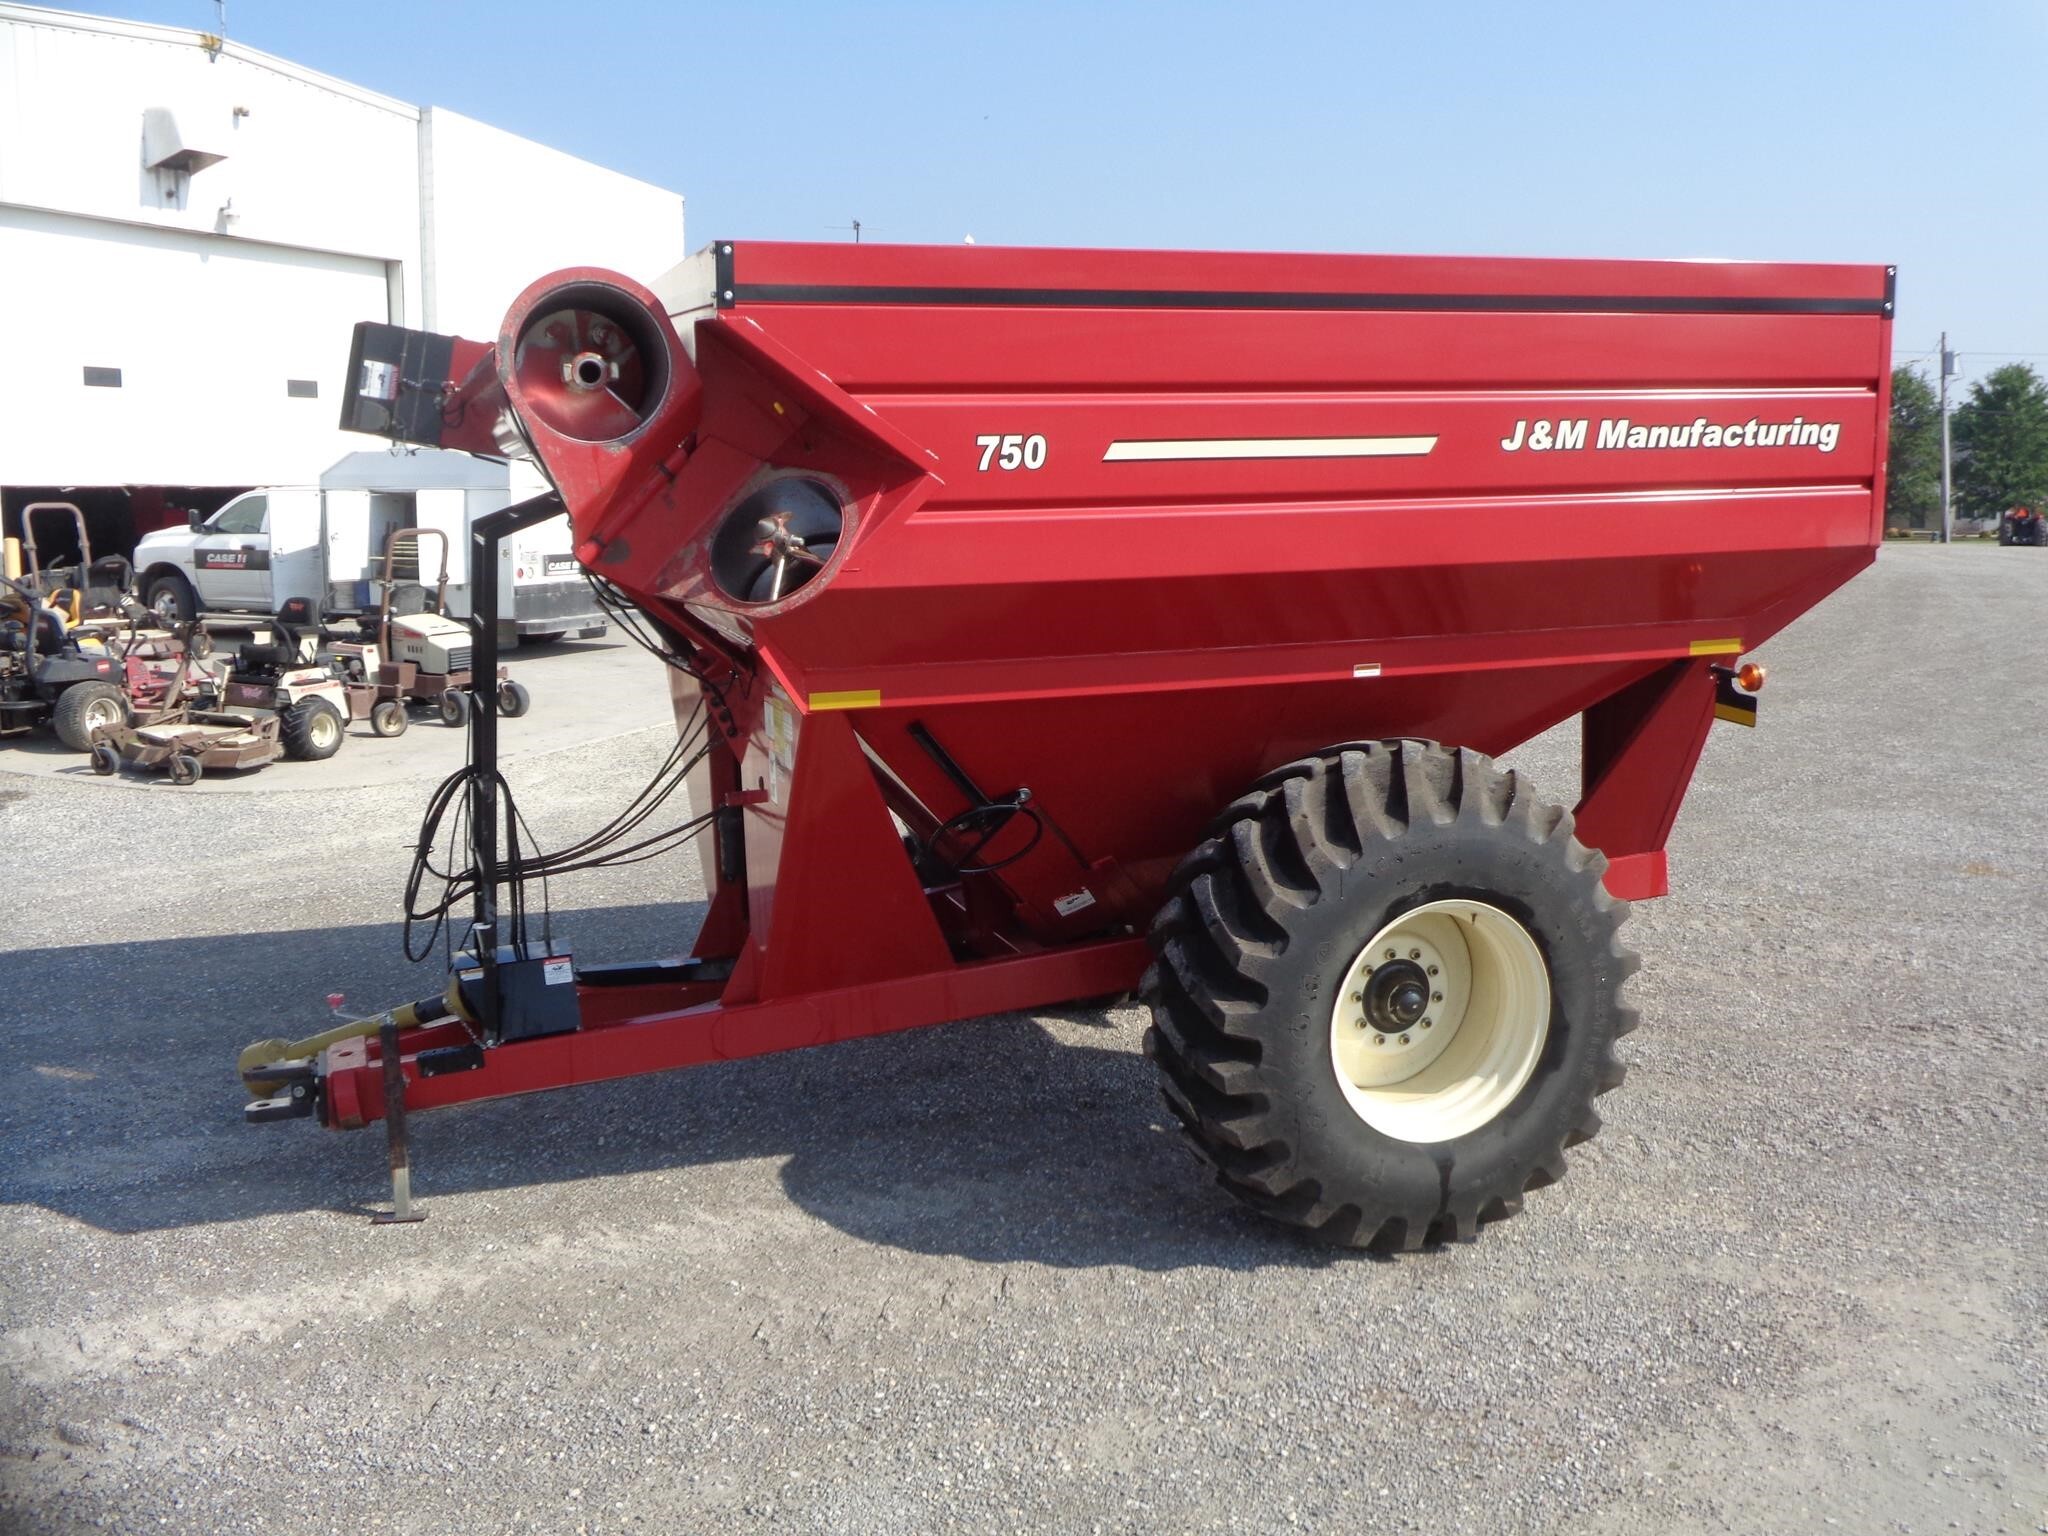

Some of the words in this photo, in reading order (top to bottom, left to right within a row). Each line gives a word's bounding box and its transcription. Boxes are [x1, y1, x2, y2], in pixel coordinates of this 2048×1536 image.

[1500, 418, 1589, 452] J&M
[1595, 415, 1841, 453] Manufacturing
[976, 433, 1047, 472] 750
[206, 553, 236, 563] CASE
[548, 561, 571, 571] CASE
